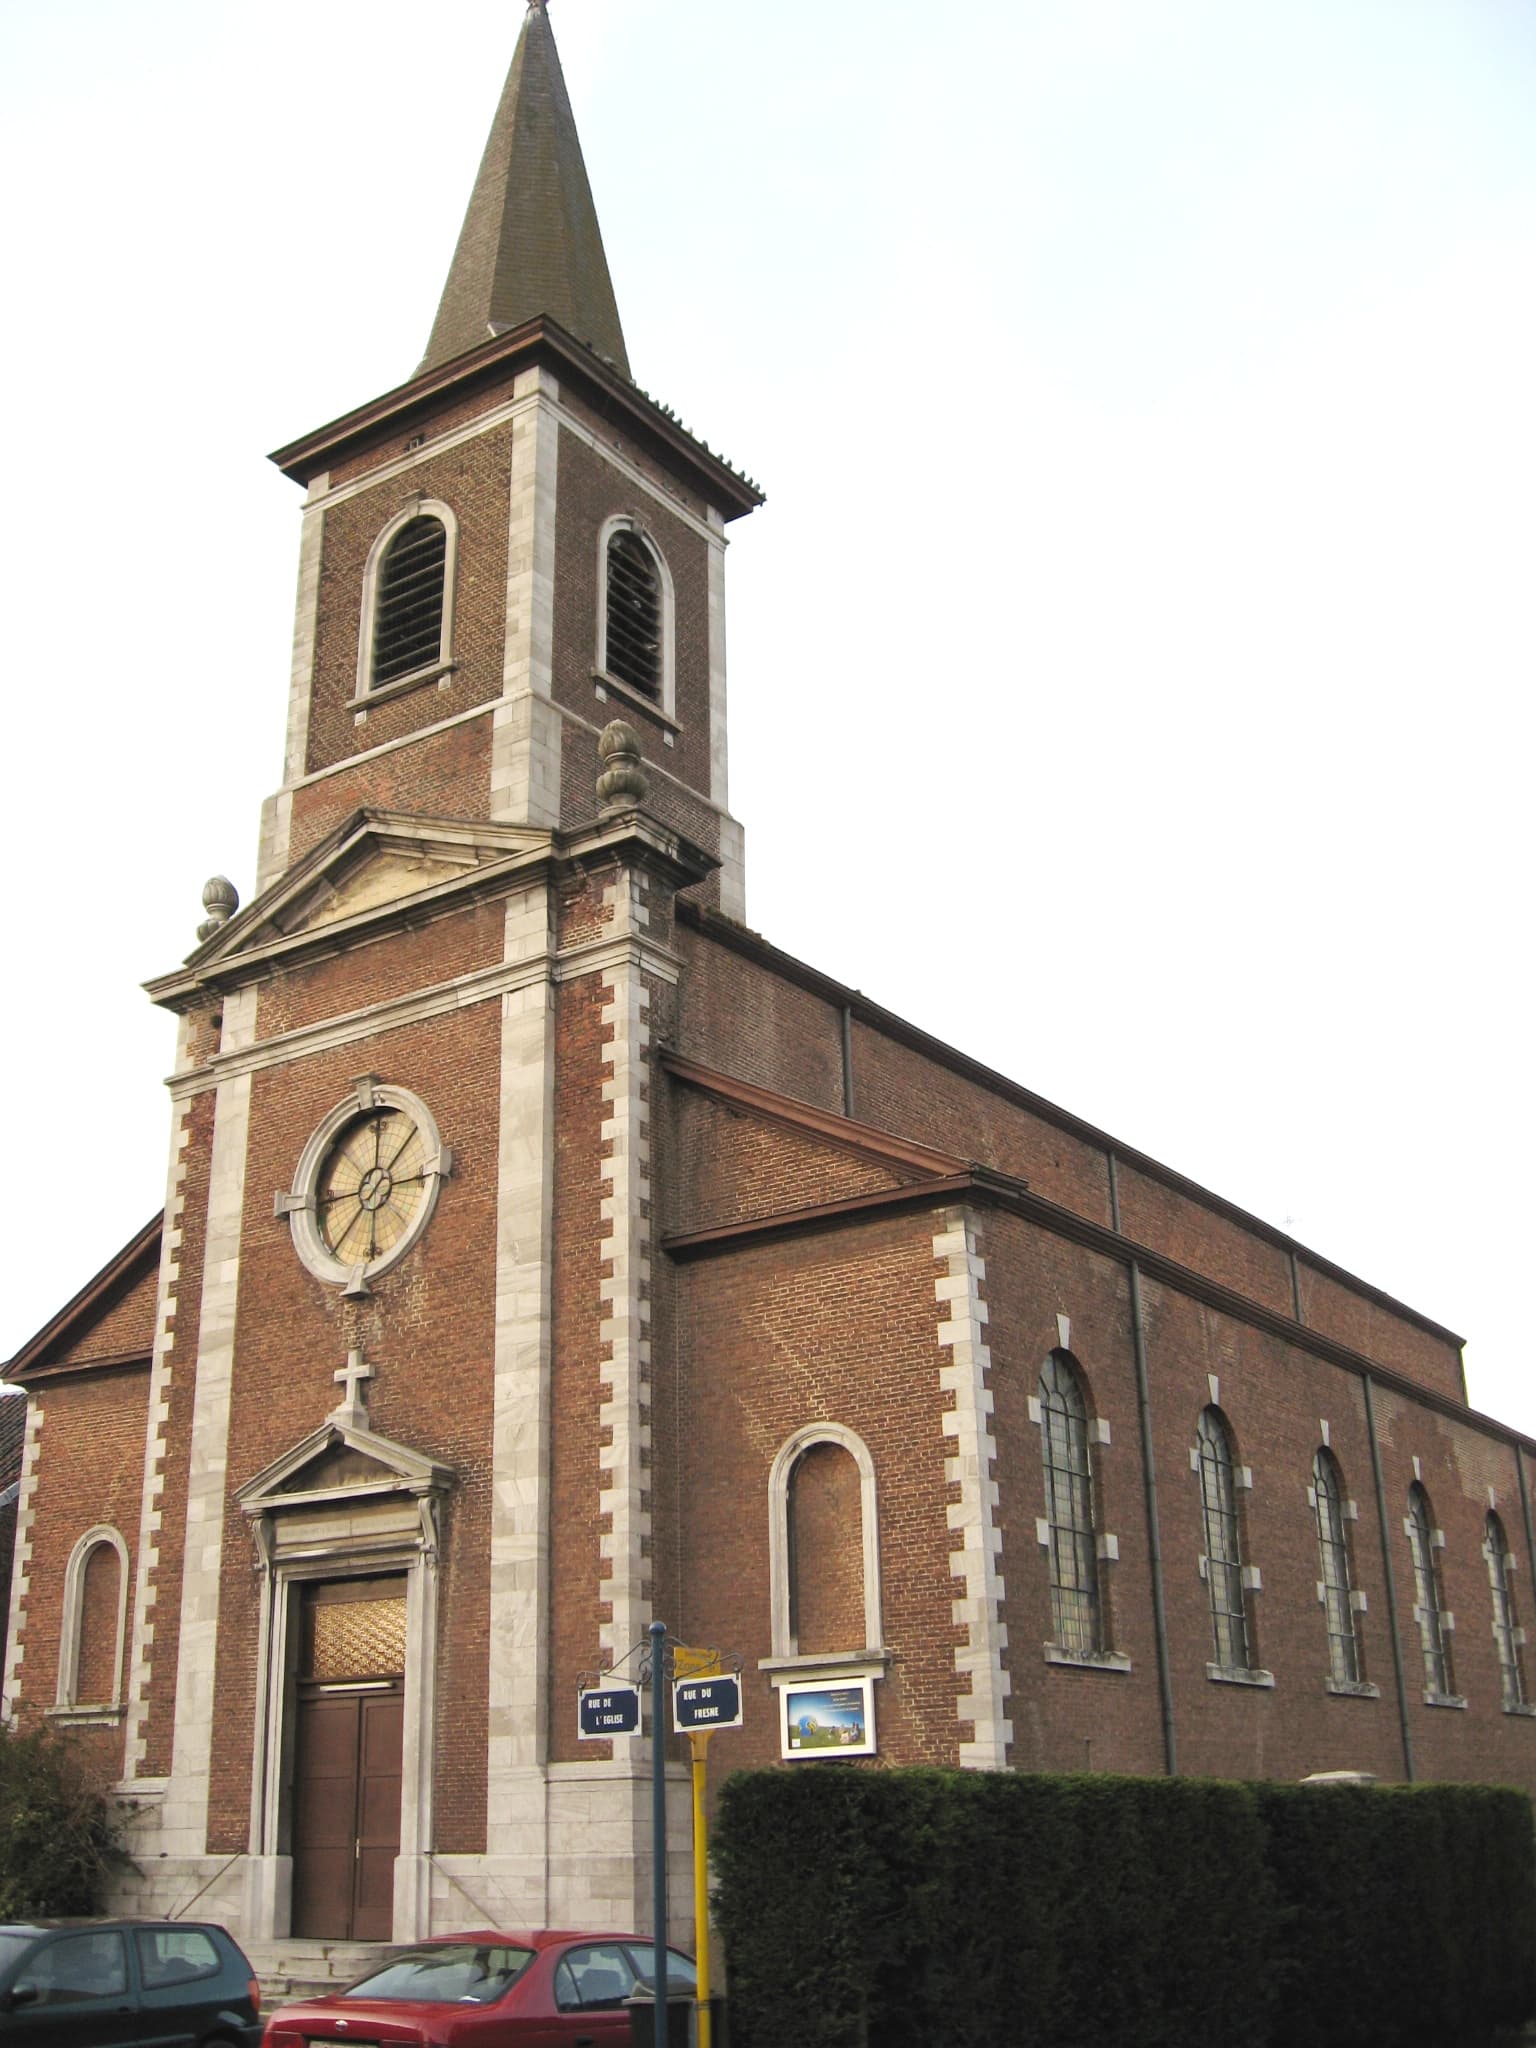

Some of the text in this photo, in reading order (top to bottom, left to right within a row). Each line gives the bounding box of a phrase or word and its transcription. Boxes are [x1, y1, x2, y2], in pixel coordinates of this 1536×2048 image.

[683, 1688, 711, 1701] RUE DU
[588, 1698, 612, 1709] RUE DE
[694, 1707, 719, 1720] FRESNE
